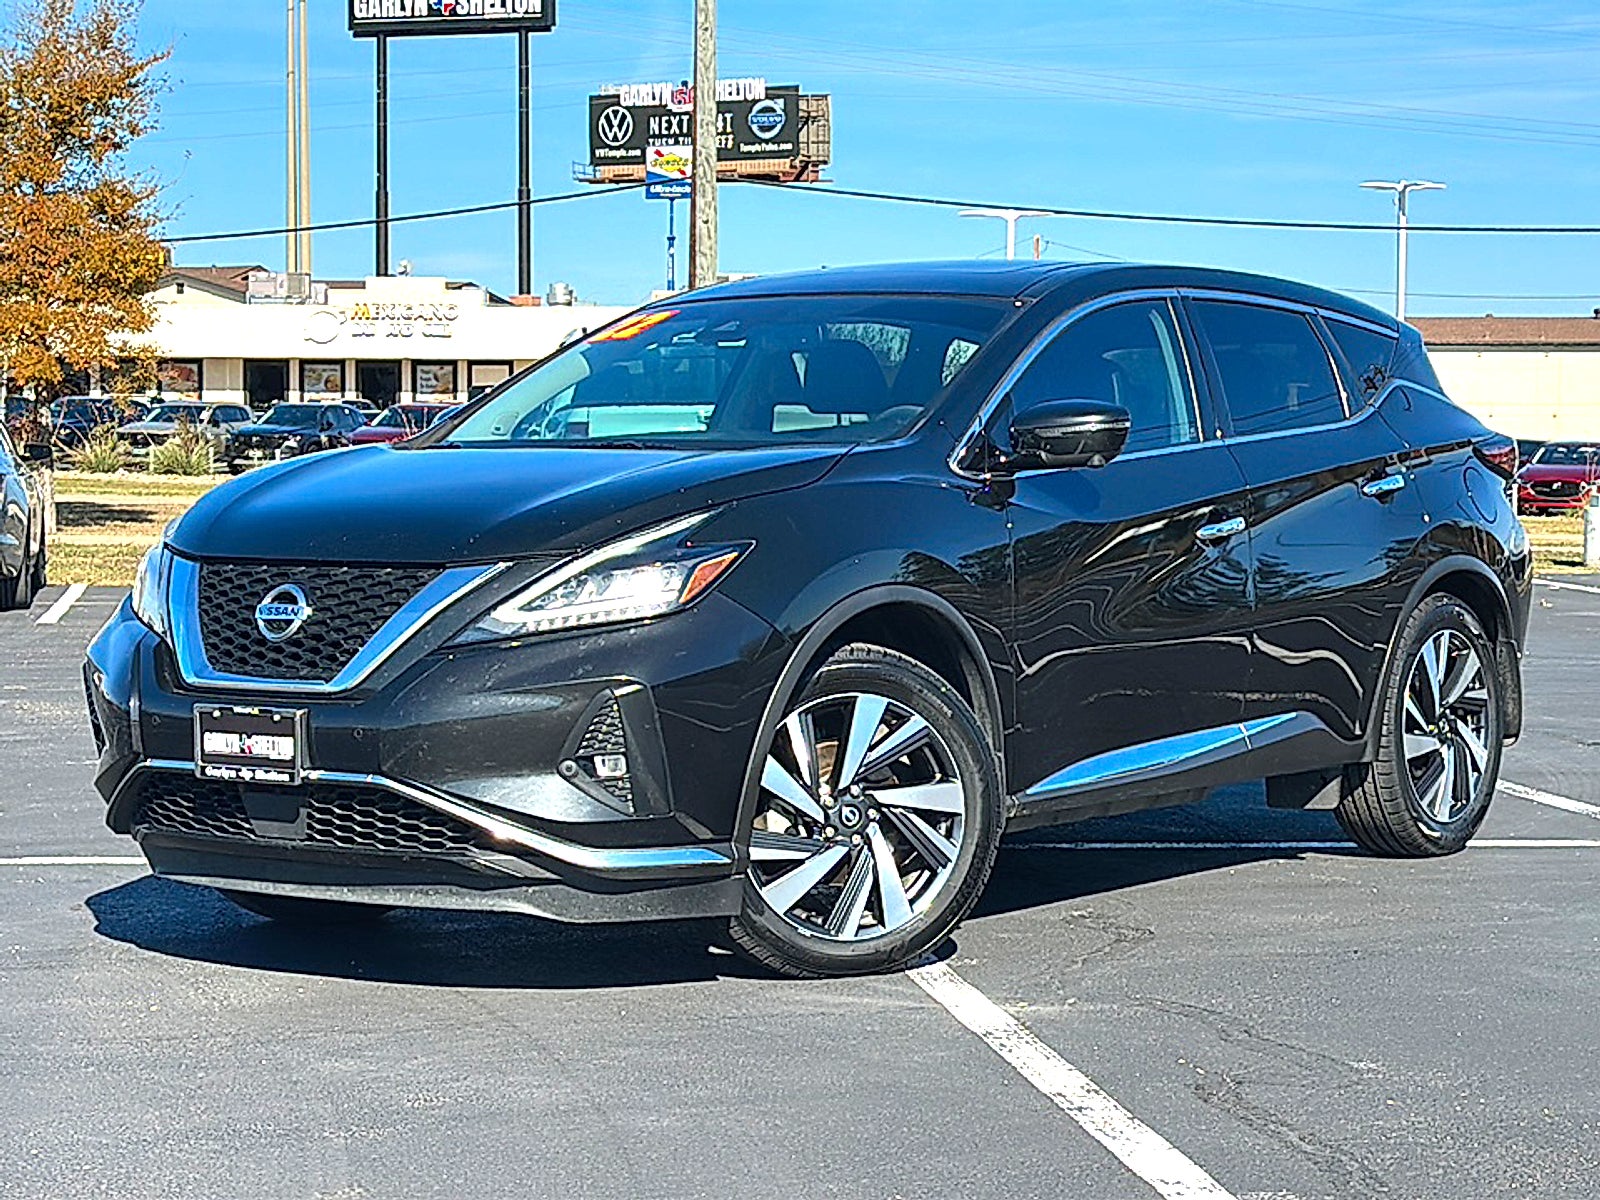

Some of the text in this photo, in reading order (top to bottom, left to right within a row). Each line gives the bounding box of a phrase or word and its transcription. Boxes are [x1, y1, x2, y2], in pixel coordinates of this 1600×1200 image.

[620, 83, 672, 106] GARLYN
[715, 77, 765, 101] HELTON
[649, 115, 690, 135] NEXT
